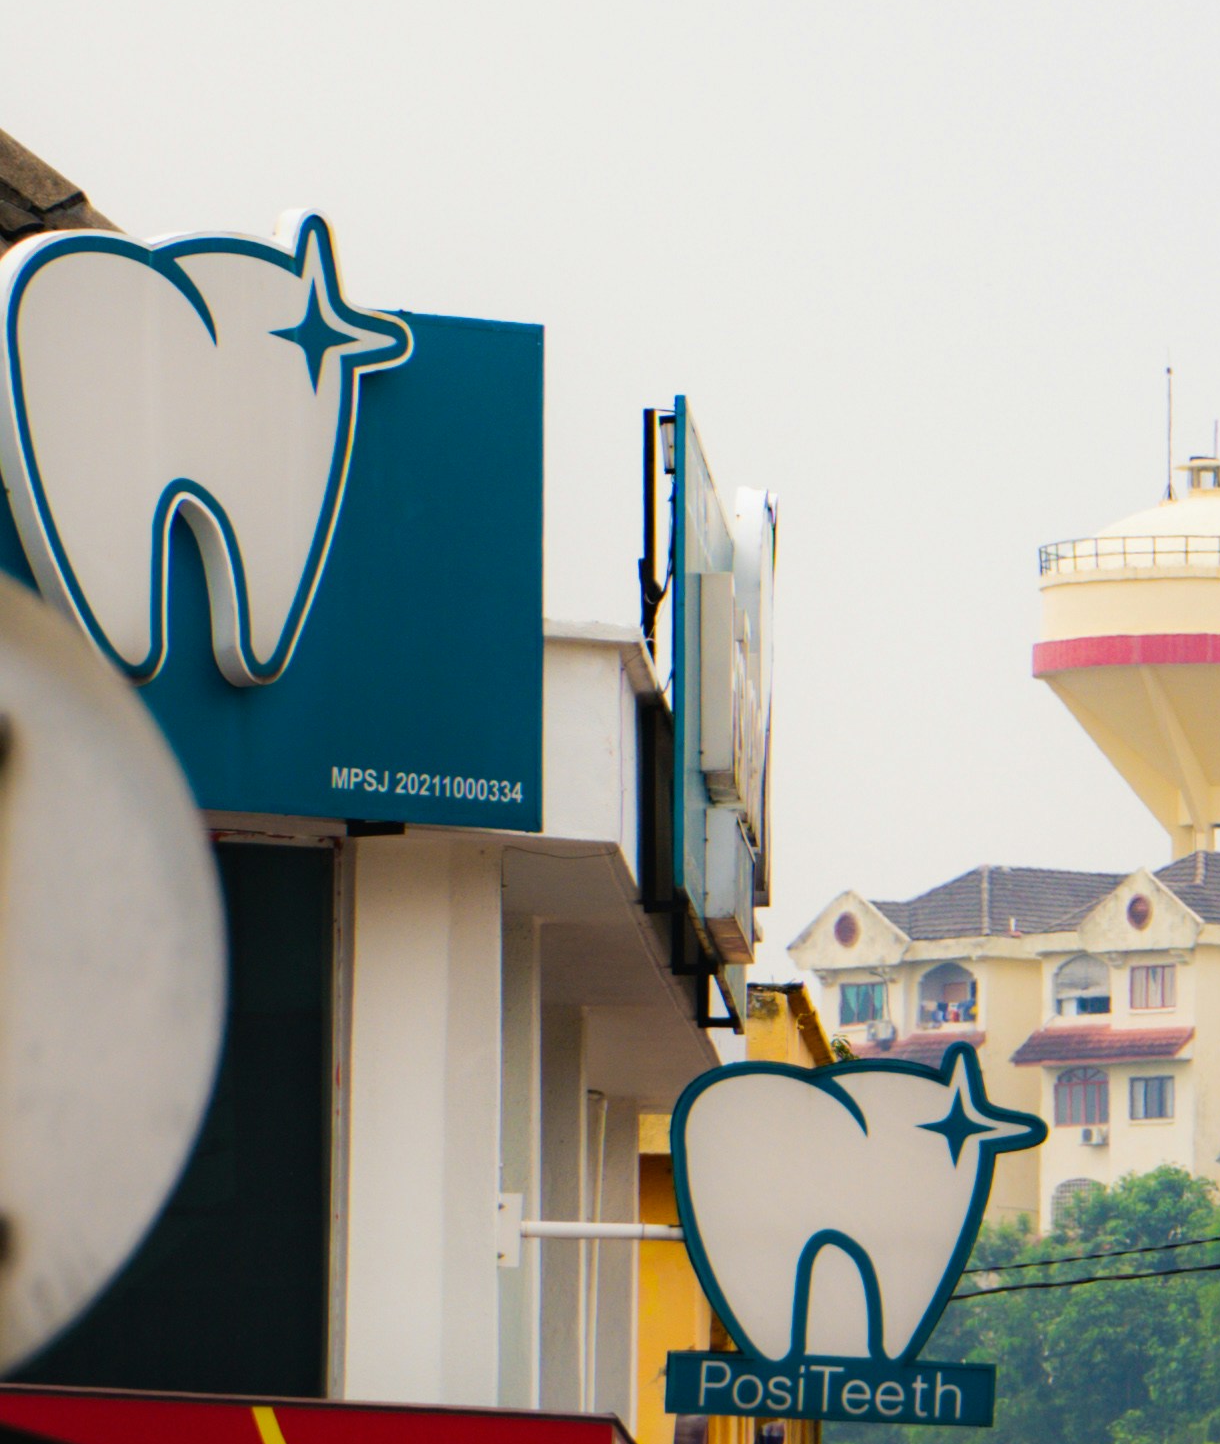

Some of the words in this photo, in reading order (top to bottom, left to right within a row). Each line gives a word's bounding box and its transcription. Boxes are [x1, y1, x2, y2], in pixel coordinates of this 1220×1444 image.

[331, 766, 389, 793] MPSJ
[394, 772, 523, 804] 20211000334
[698, 1359, 963, 1420] PosiTeeth
